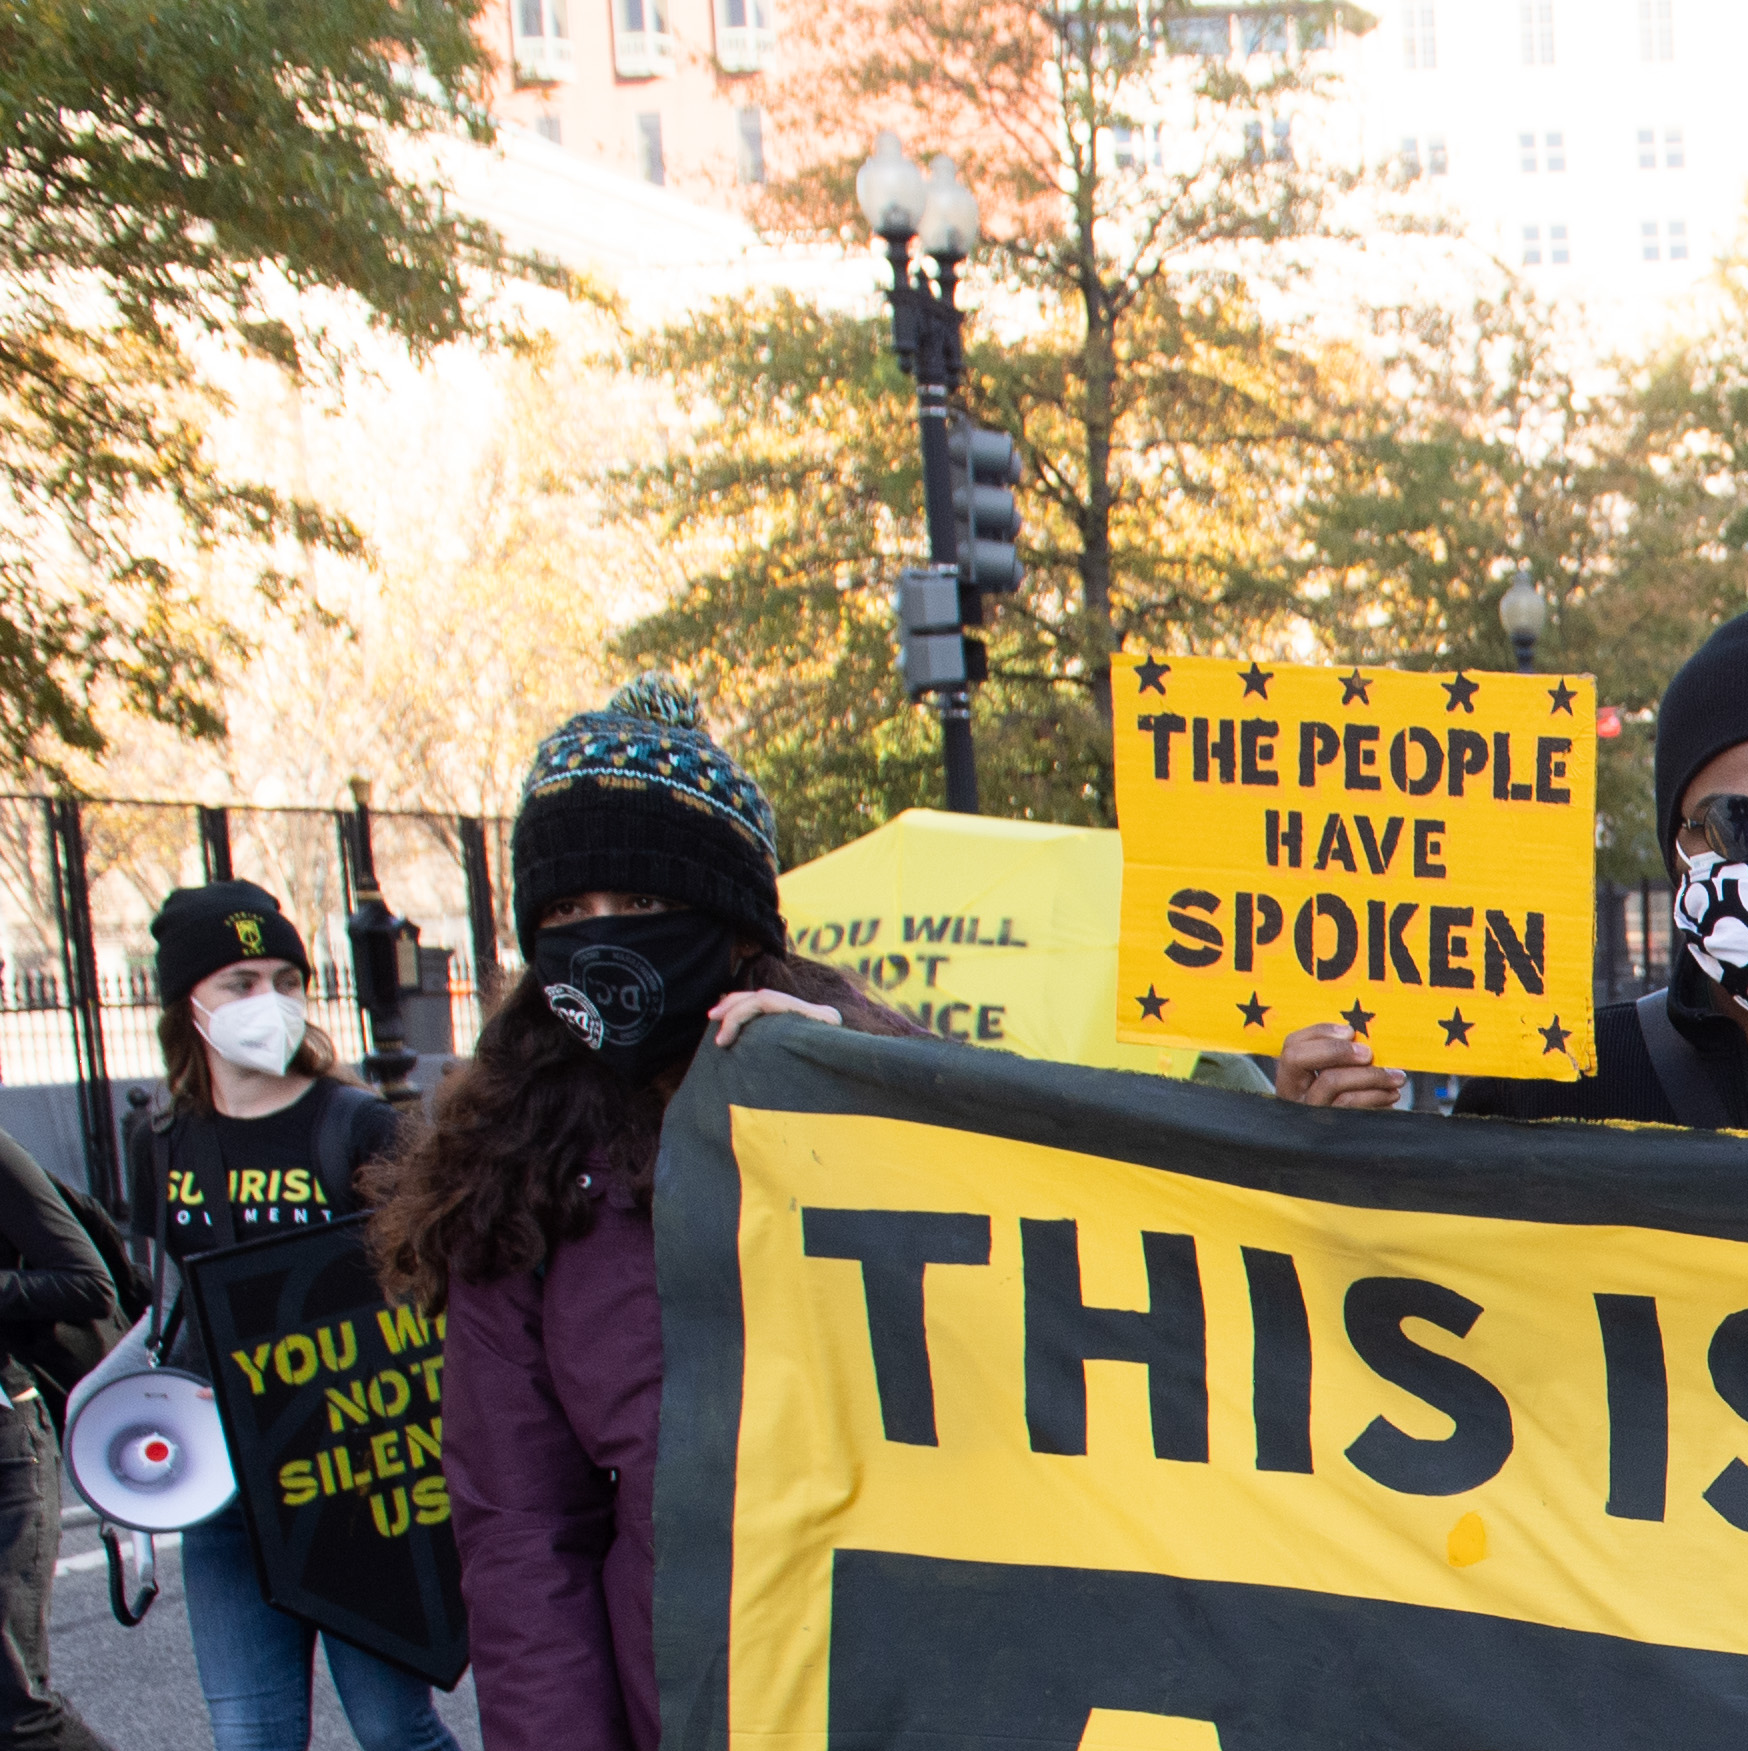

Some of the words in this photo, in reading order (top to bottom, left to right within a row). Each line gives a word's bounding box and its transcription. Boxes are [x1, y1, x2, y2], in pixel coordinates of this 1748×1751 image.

[1137, 712, 1280, 787] THE
[1298, 721, 1572, 804] PEOPLE
[1265, 809, 1446, 878] HAVE
[903, 916, 1028, 948] WILL
[1164, 888, 1545, 996] SPOKEN
[231, 1320, 358, 1395] YOU
[802, 1207, 1514, 1497] THIS
[325, 1355, 445, 1434] NOT
[279, 1417, 442, 1506] SILEN
[369, 1475, 452, 1538] US
